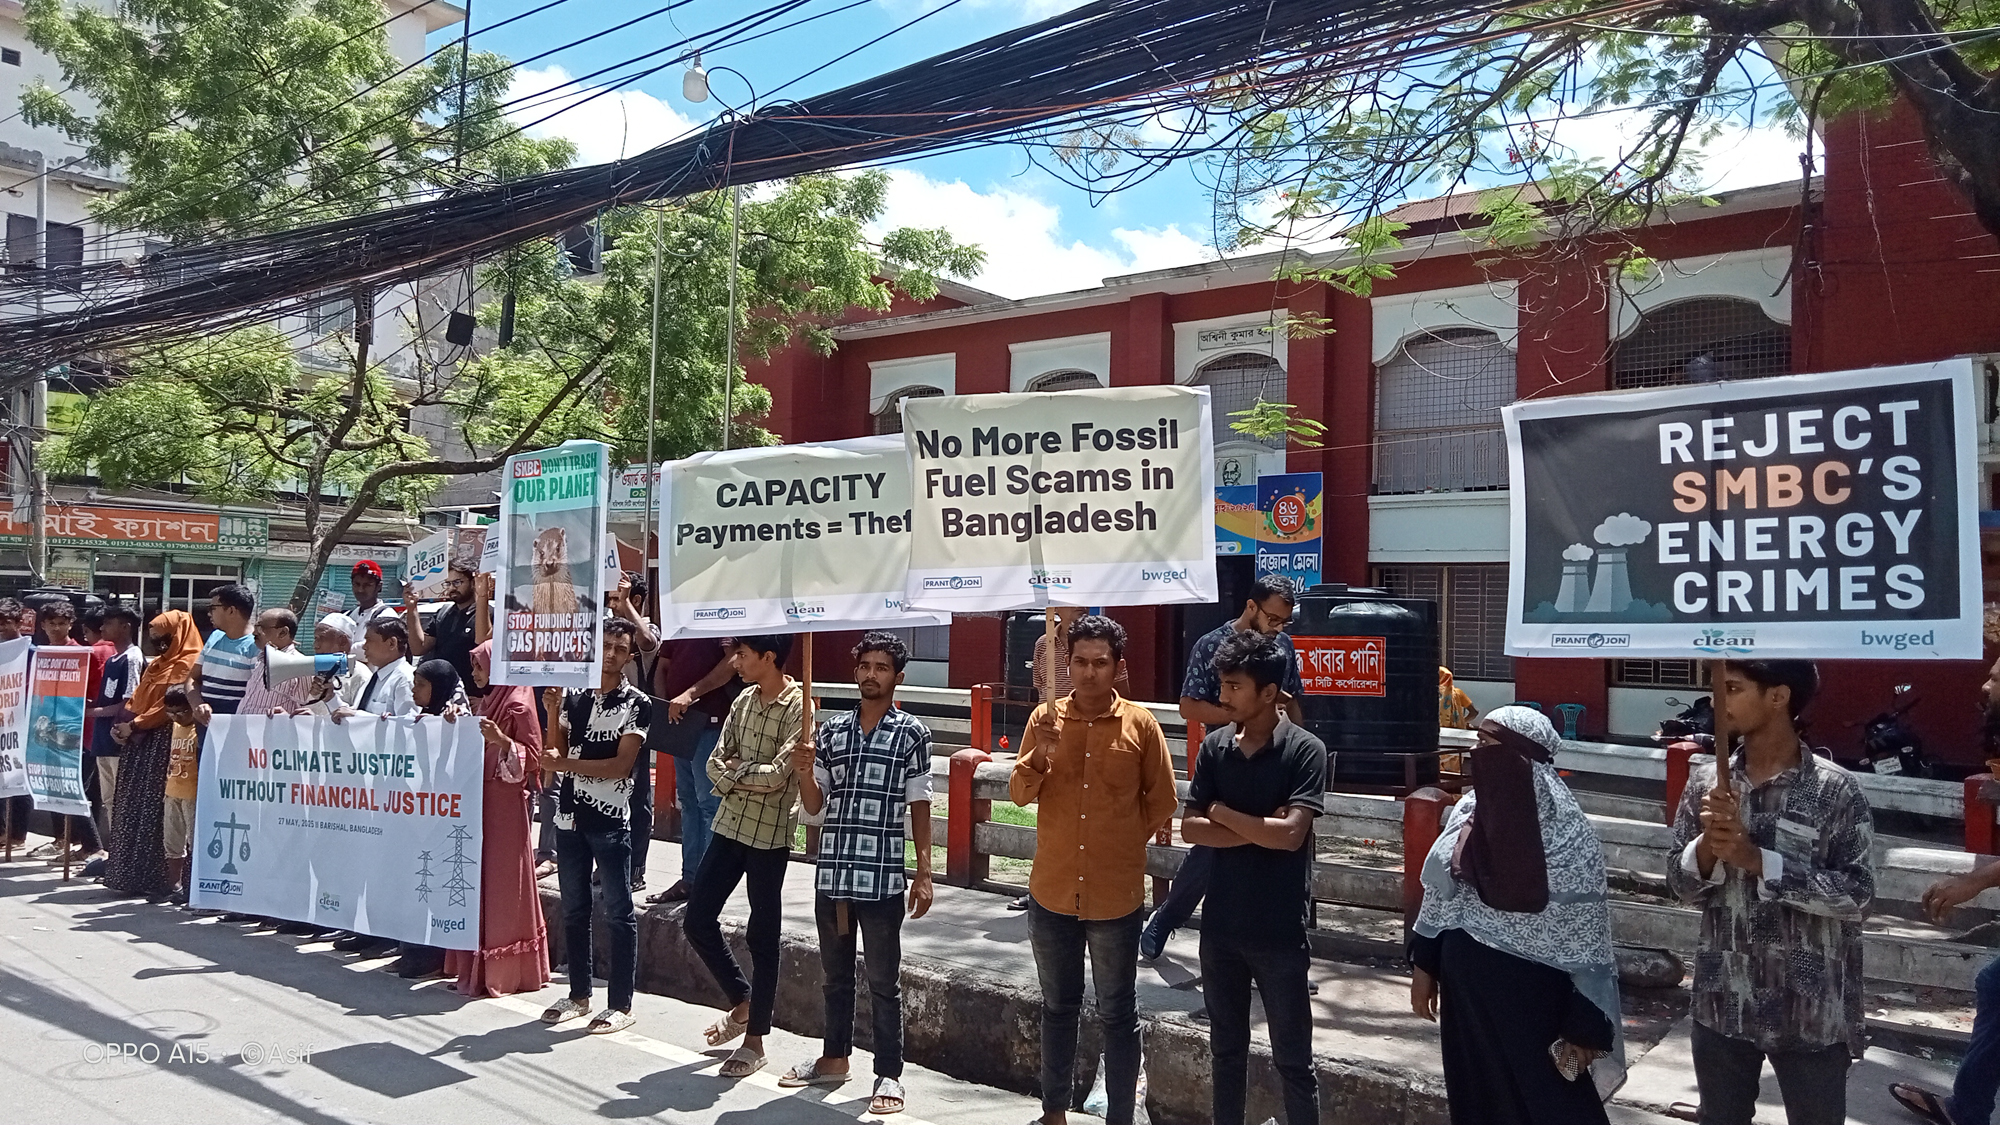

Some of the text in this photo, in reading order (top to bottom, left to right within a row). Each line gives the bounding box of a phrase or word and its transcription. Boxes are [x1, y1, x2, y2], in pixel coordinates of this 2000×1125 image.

[916, 418, 1179, 459] No More Fossil
[1658, 400, 1920, 465] REJECT
[514, 452, 597, 477] SMBC DON'T TRASH
[514, 472, 597, 503] OUR PLANET
[716, 472, 886, 508] CAPACITY
[925, 459, 1174, 499] Fuel Scams in
[1672, 455, 1923, 514] SMBC'S
[109, 517, 217, 542] ফ্যাশন
[676, 508, 911, 549] Payments = Thef
[941, 500, 1157, 543] Bangladesh
[1278, 514, 1299, 527] তম
[486, 540, 499, 551] PRA
[1657, 508, 1923, 564] ENERGY
[410, 553, 445, 576] clean
[1258, 548, 1319, 572] বিজ্ঞান মেলা
[1028, 574, 1072, 584] clean
[1141, 568, 1187, 583] bwged
[1672, 564, 1926, 615] CRIMES
[508, 612, 592, 629] STOP FUNDING NEW
[786, 606, 825, 615] clean
[507, 631, 592, 657] GAS PROJECTS
[1693, 635, 1755, 646] clean
[1860, 629, 1934, 652] bwged
[1309, 646, 1346, 674] খাবার
[1350, 642, 1380, 675] পানি
[1315, 676, 1333, 688] সিটি
[1335, 677, 1378, 689] কর্পোরেশন
[249, 748, 415, 778] NO CLIMATE JUSTICE
[220, 778, 462, 818] WITHOUT FINANCIAL JUSTICE
[278, 817, 285, 825] 27
[349, 824, 383, 836] BANGLADESH
[199, 881, 220, 890] RANT
[319, 896, 340, 907] clean
[431, 914, 465, 933] bwged
